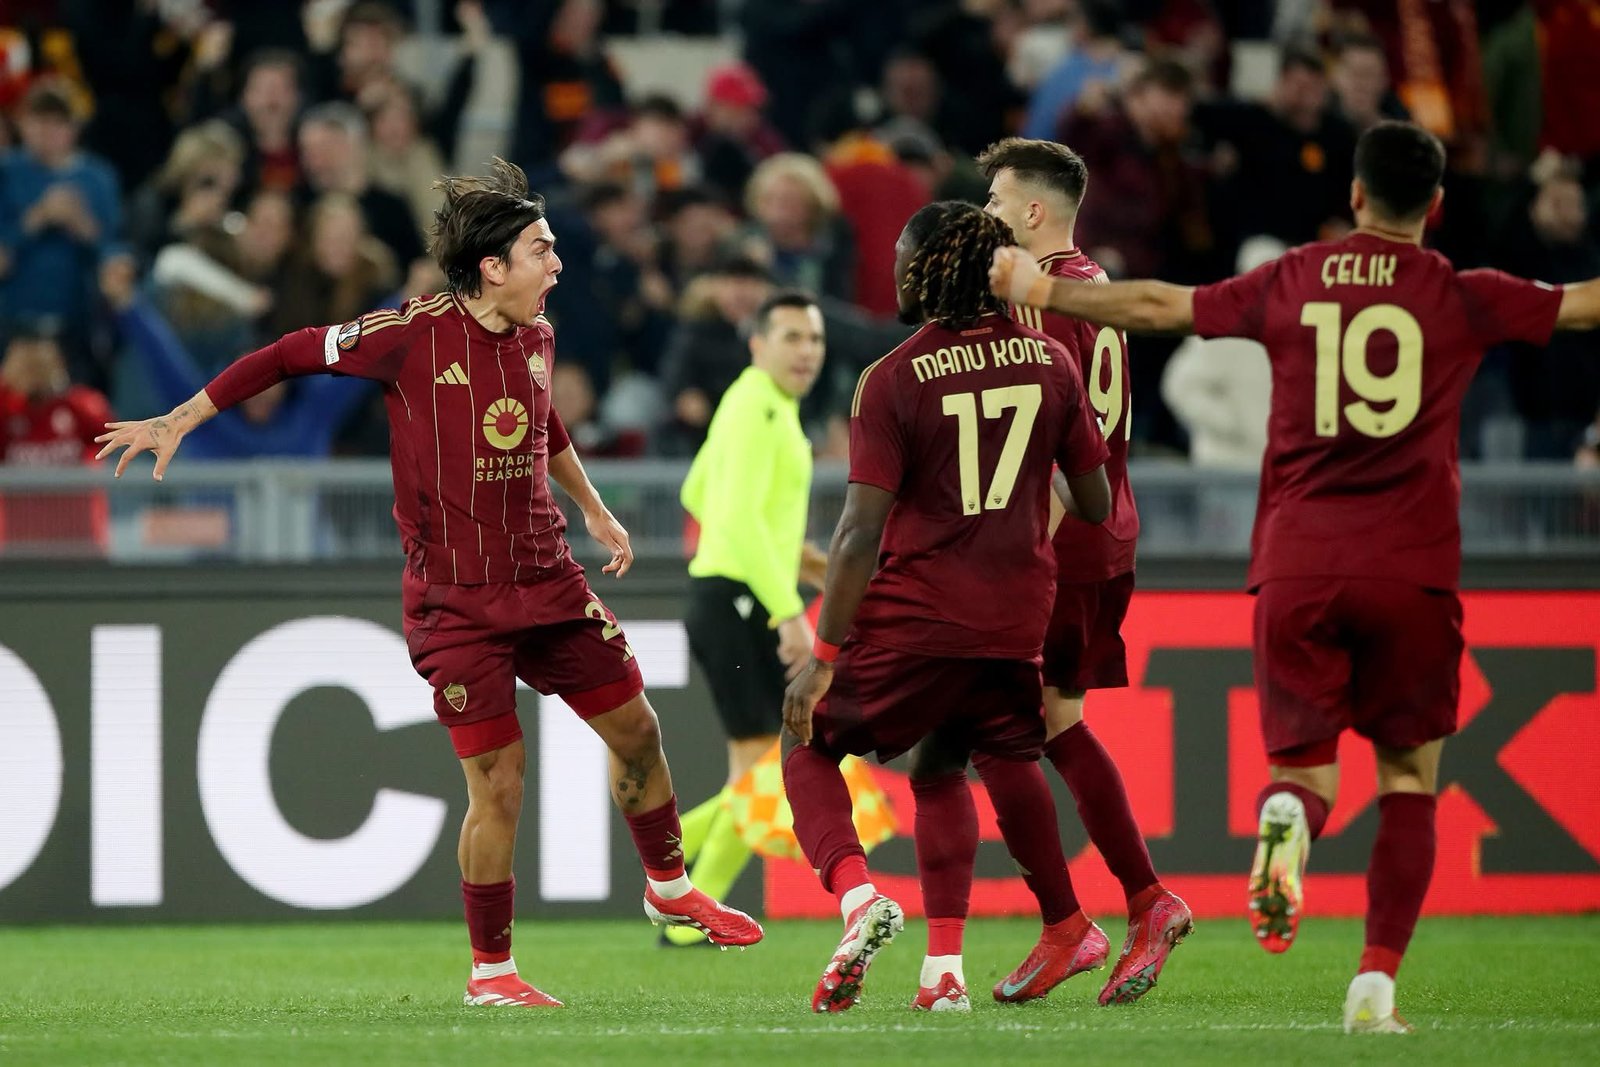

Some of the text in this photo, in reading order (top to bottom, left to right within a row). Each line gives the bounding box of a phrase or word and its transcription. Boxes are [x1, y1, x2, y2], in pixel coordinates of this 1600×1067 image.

[1321, 253, 1397, 289] ÇELIK
[911, 337, 1053, 383] MANU KONE
[1300, 302, 1424, 438] 19
[1088, 326, 1132, 441] 9
[476, 454, 534, 469] RIYADH
[942, 384, 1043, 516] 17
[475, 466, 533, 482] SEASON
